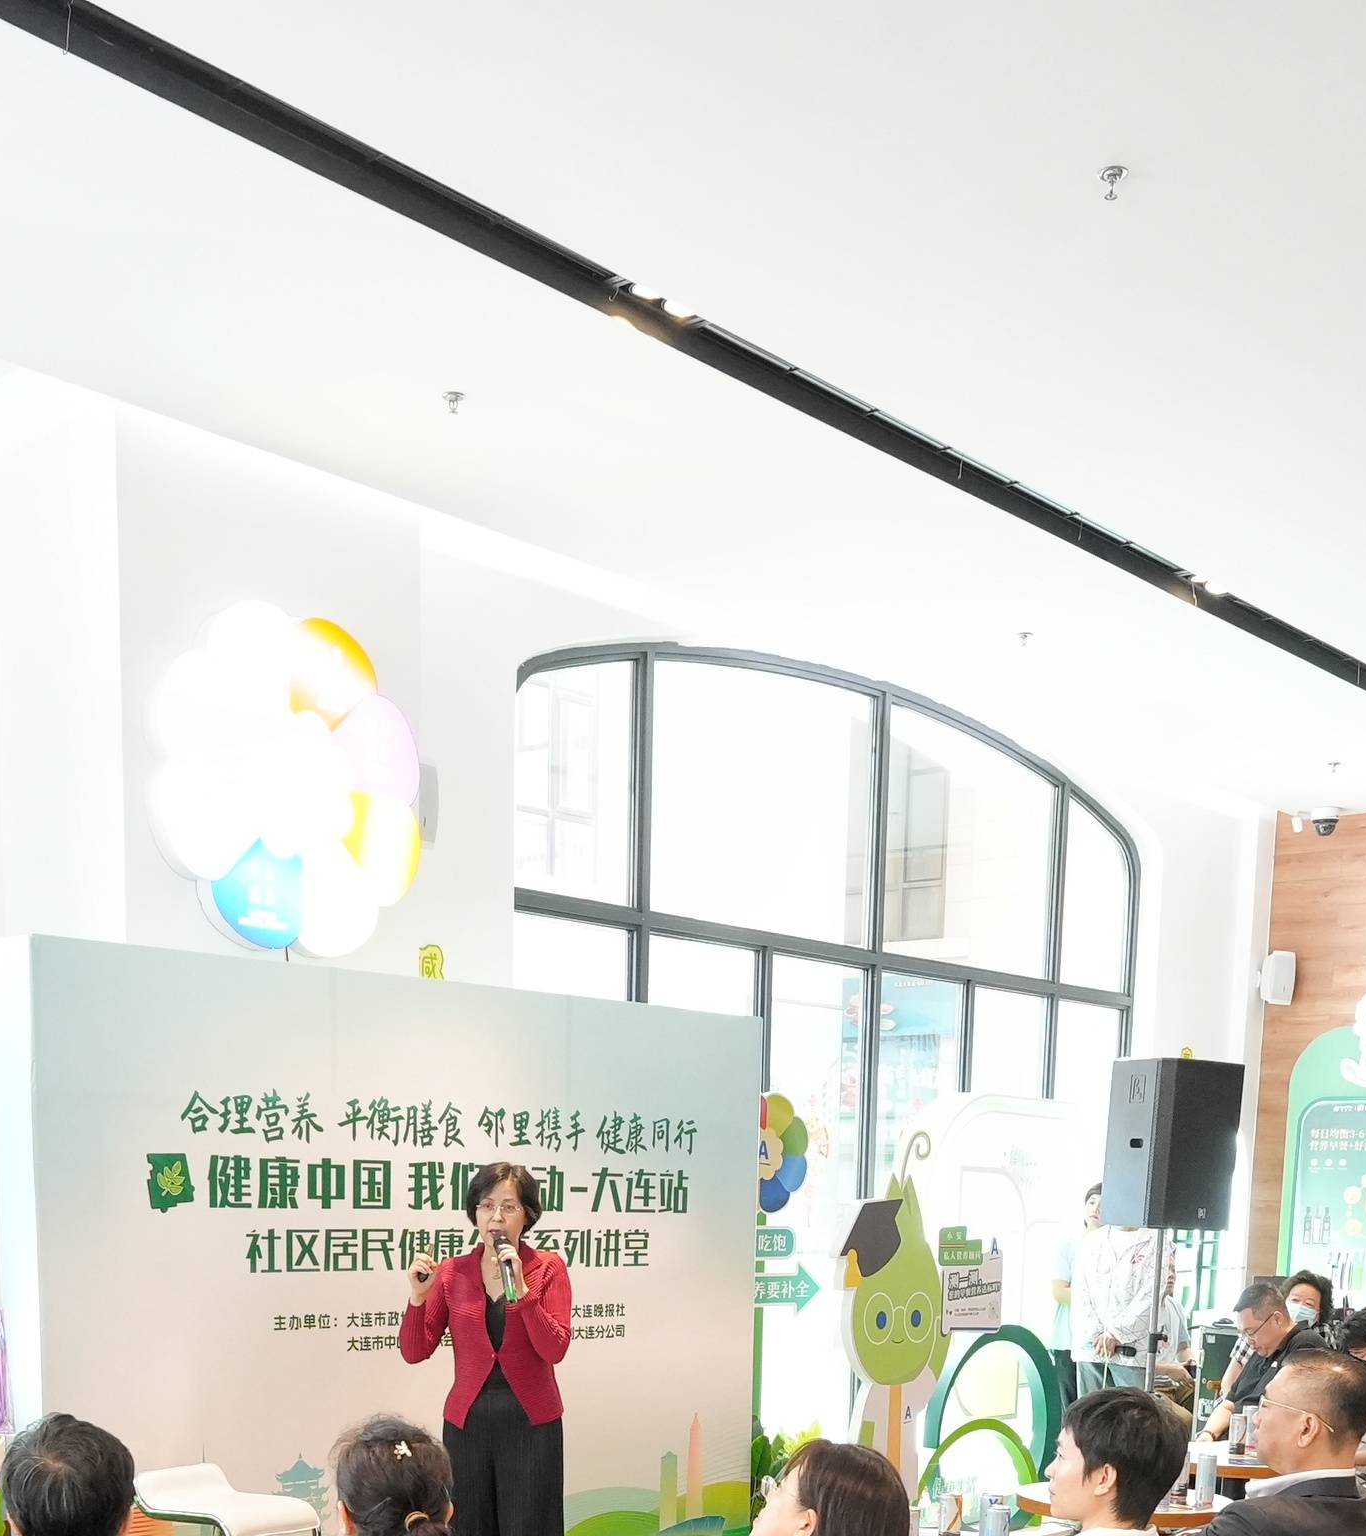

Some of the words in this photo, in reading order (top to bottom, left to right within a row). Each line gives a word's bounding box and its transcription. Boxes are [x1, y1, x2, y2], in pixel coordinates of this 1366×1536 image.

[180, 1089, 324, 1144] 合理营养
[337, 1095, 465, 1149] 平衡膳食
[478, 1105, 586, 1153] 邻里携手
[596, 1110, 698, 1156] 健康同行
[207, 1155, 392, 1210] 健康中国
[408, 1161, 689, 1214] 我们动-大连站
[758, 1234, 787, 1252] 吃饱
[991, 1237, 999, 1255] A
[571, 1303, 626, 1319] 大连晚报社
